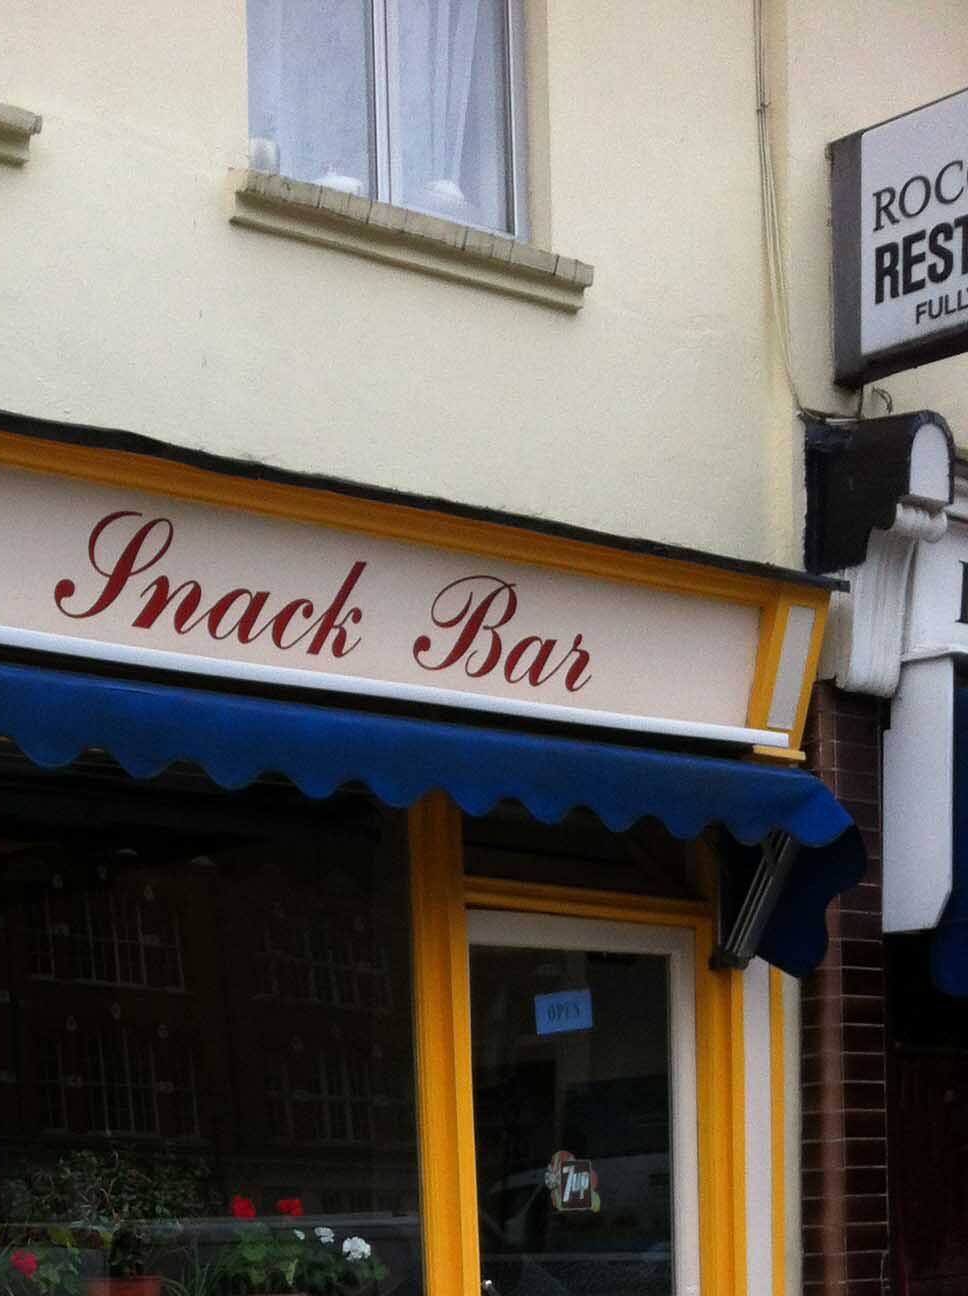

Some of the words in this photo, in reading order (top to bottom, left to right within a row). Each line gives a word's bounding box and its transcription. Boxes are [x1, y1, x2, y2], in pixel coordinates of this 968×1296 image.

[872, 159, 968, 233] ROC
[915, 287, 968, 325] FULL
[54, 510, 367, 659] Snack
[412, 575, 592, 693] Bar
